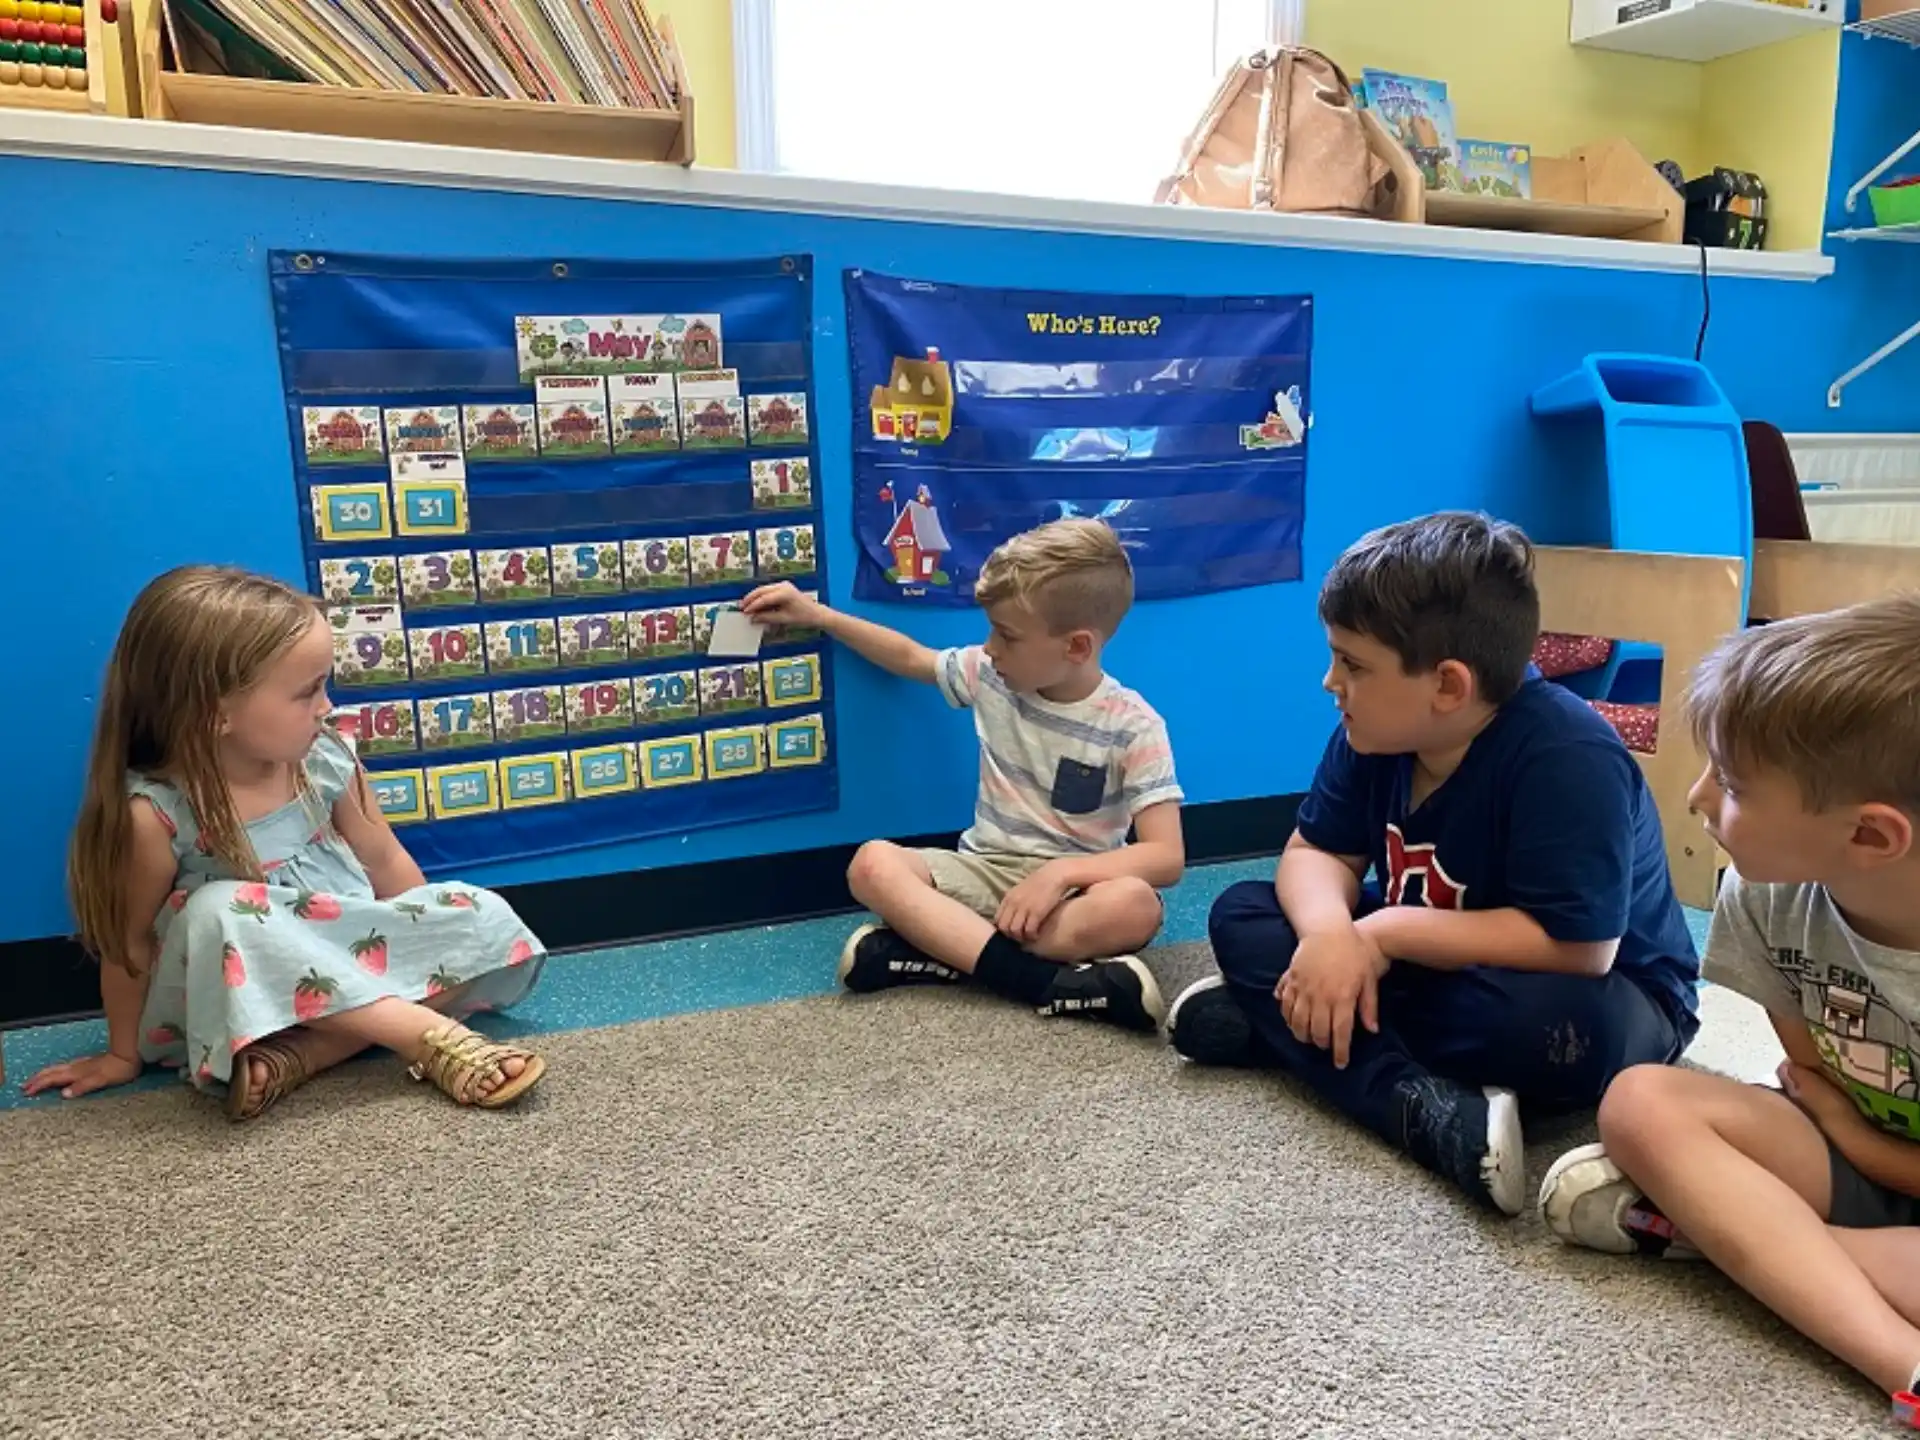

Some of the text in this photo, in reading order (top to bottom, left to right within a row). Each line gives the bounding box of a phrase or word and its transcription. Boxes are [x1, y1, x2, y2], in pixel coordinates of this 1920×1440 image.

[1027, 312, 1161, 337] Who's Here?
[588, 331, 652, 360] May
[623, 375, 659, 386] TODAY
[774, 463, 789, 493] 1
[340, 501, 371, 521] 30
[418, 497, 444, 518] 31
[645, 542, 668, 573] 6
[709, 536, 732, 568] 7
[775, 529, 795, 560] 8
[345, 561, 373, 595] 2
[424, 556, 450, 591] 3
[503, 553, 527, 586] 4
[574, 546, 599, 579] 5
[505, 624, 540, 657] 11
[574, 617, 613, 650] 12
[642, 612, 678, 644] 13
[356, 635, 382, 669] 9
[427, 630, 468, 664] 10
[646, 675, 686, 707] 20
[709, 669, 746, 700] 21
[779, 671, 805, 691] 22
[508, 690, 549, 725] 18
[579, 684, 618, 716] 19
[358, 705, 398, 740] 16
[433, 699, 473, 733] 17
[721, 743, 748, 763] 28
[784, 732, 809, 751] 29
[590, 759, 618, 779] 26
[658, 752, 686, 771] 27
[375, 785, 408, 806] 23
[448, 779, 480, 800] 24
[516, 771, 545, 791] 25
